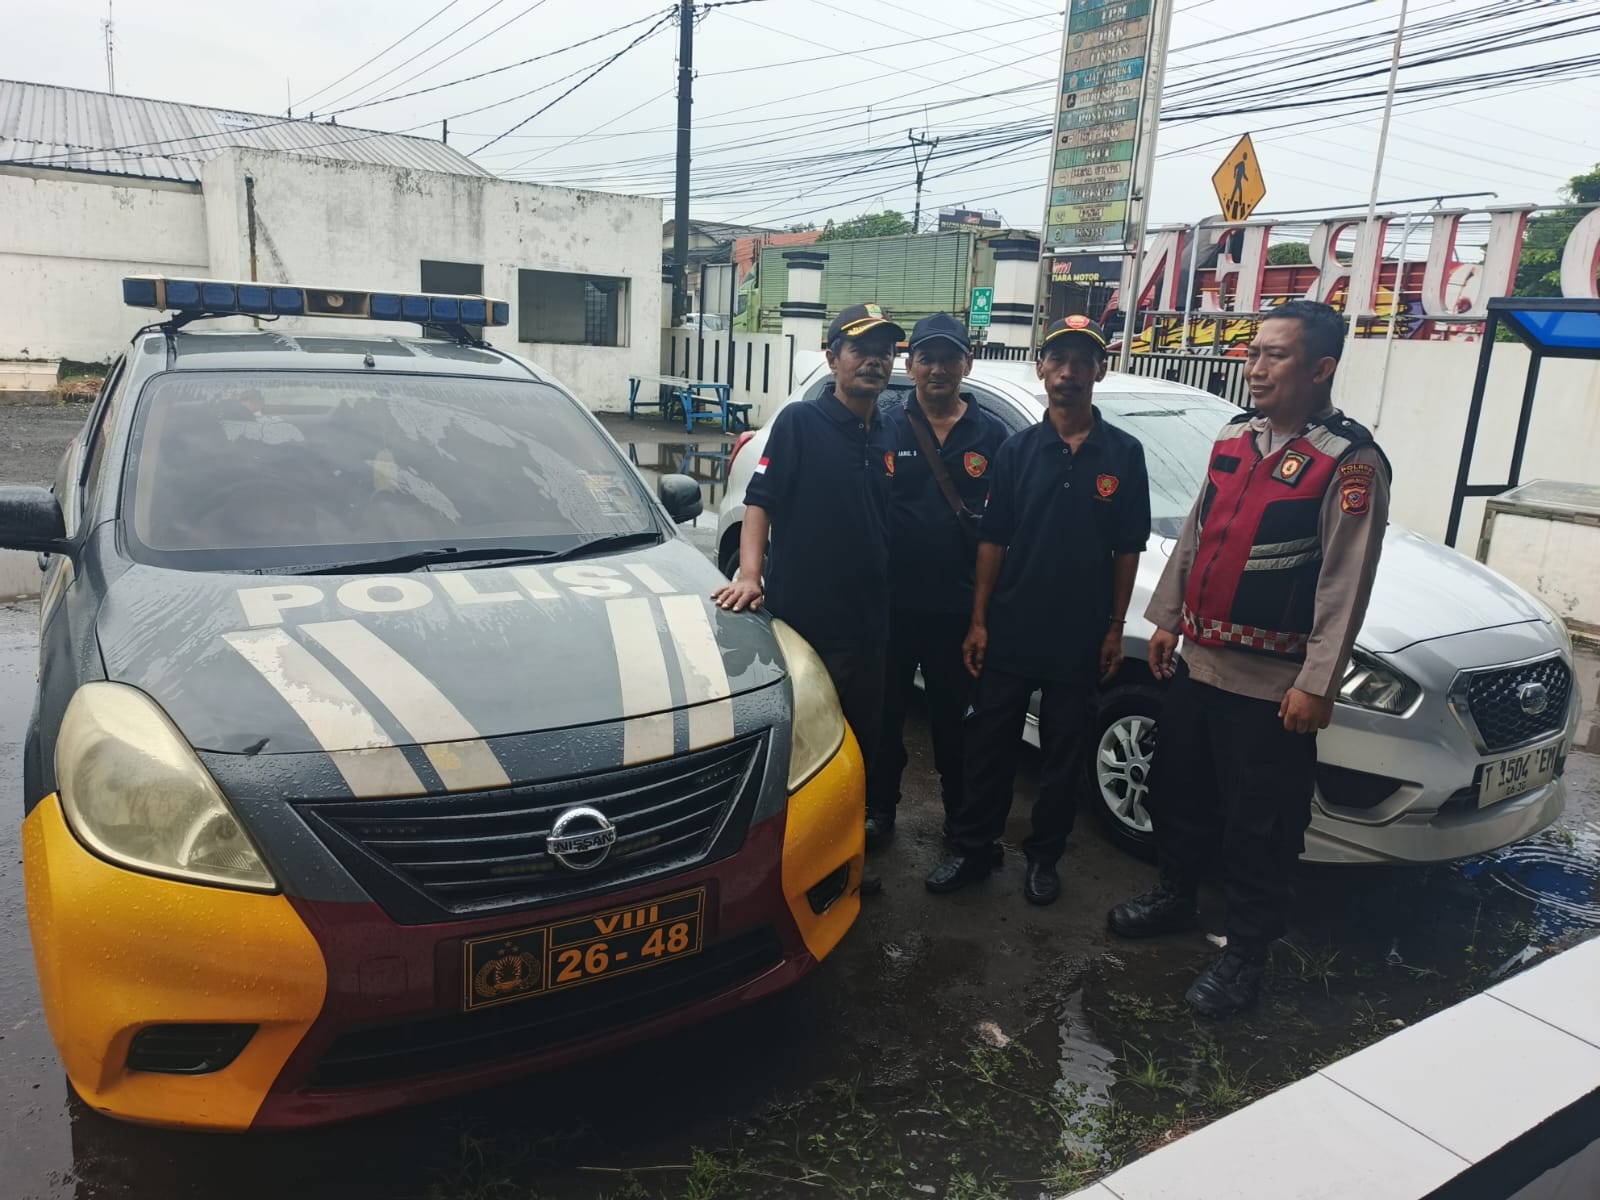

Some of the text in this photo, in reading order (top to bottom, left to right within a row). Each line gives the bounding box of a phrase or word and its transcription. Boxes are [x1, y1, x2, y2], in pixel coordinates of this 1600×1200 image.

[1073, 273, 1100, 281] MOTOR
[237, 563, 679, 627] POLISI
[1485, 766, 1493, 792] T
[1498, 754, 1531, 786] 1504
[554, 833, 614, 852] NISSAN
[593, 904, 659, 934] VIII
[556, 943, 609, 983] 26
[640, 922, 689, 958] 48
